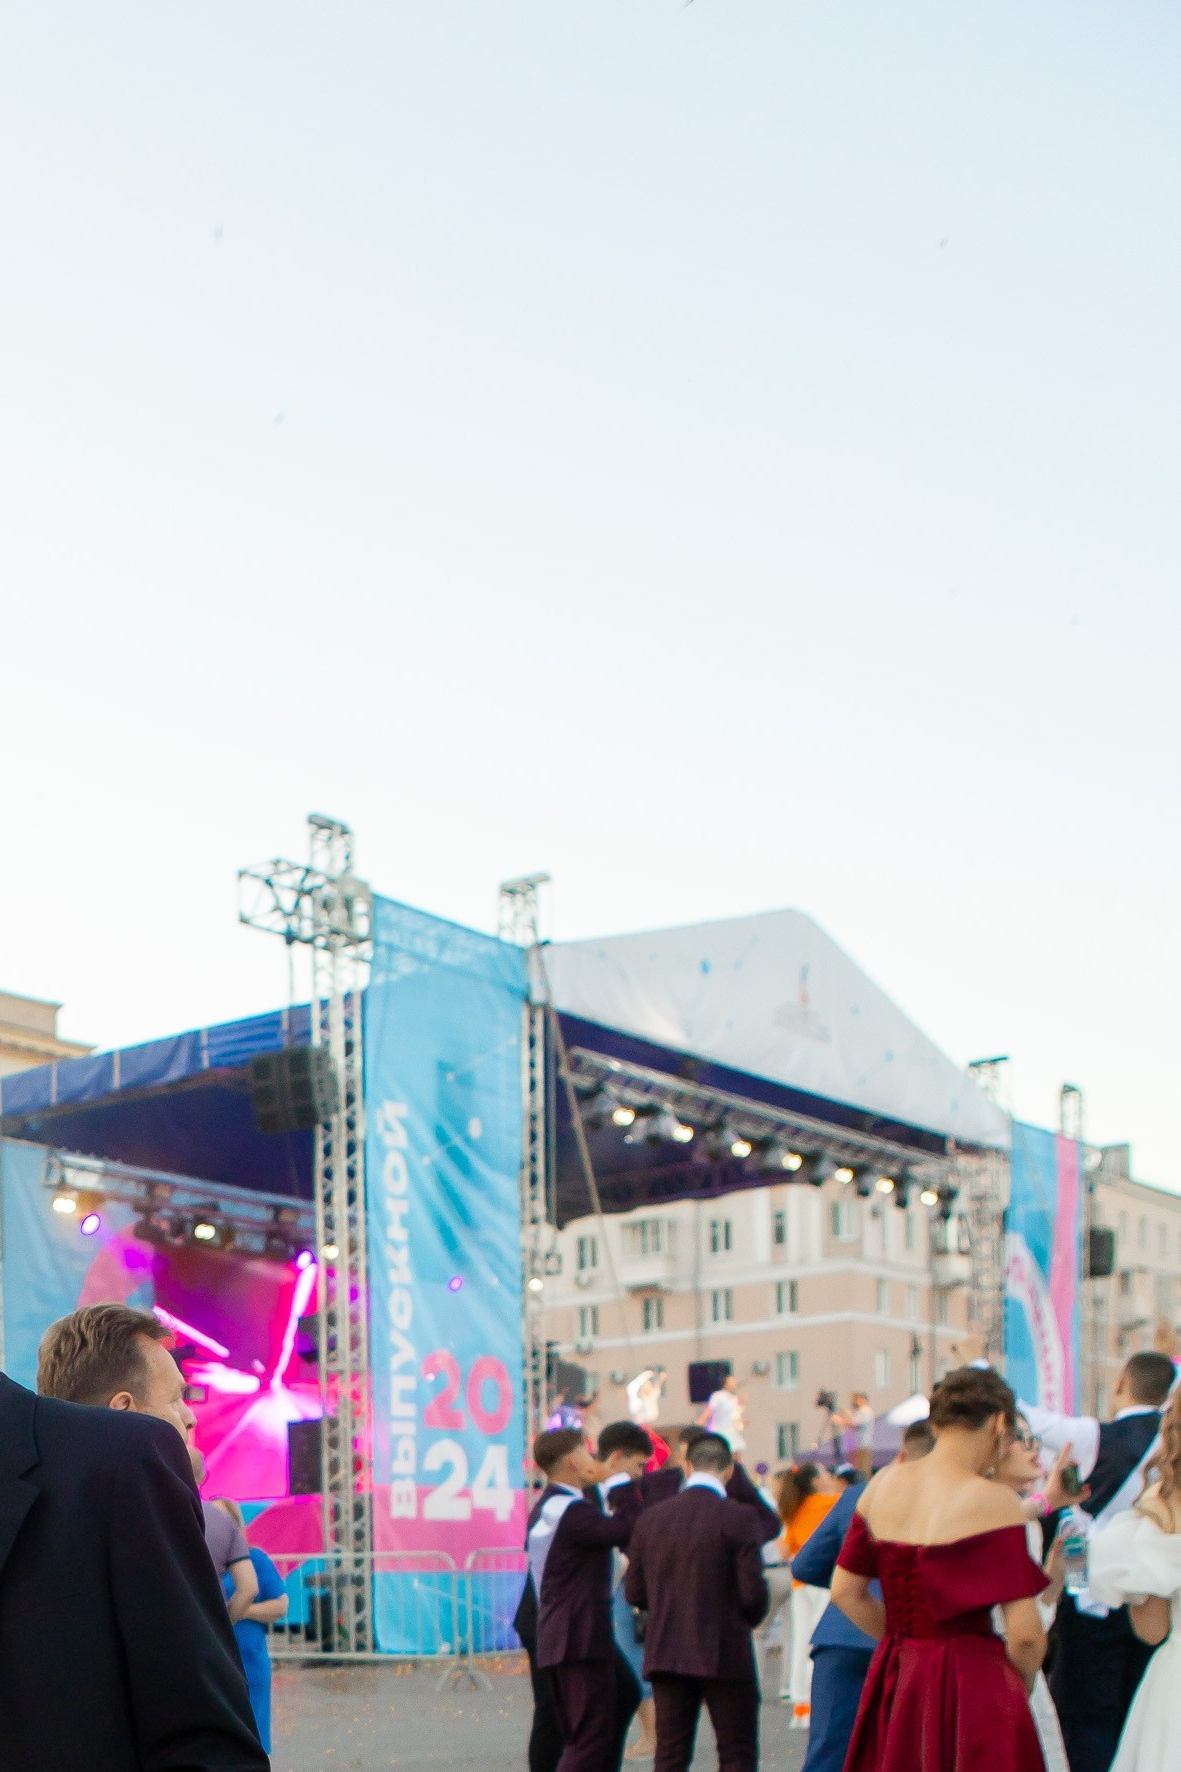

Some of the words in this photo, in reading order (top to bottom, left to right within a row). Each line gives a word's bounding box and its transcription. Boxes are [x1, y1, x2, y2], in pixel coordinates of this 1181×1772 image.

[376, 1100, 417, 1520] ВЫПУСКНОЙ
[421, 1349, 513, 1436] 20
[422, 1438, 515, 1523] 24
